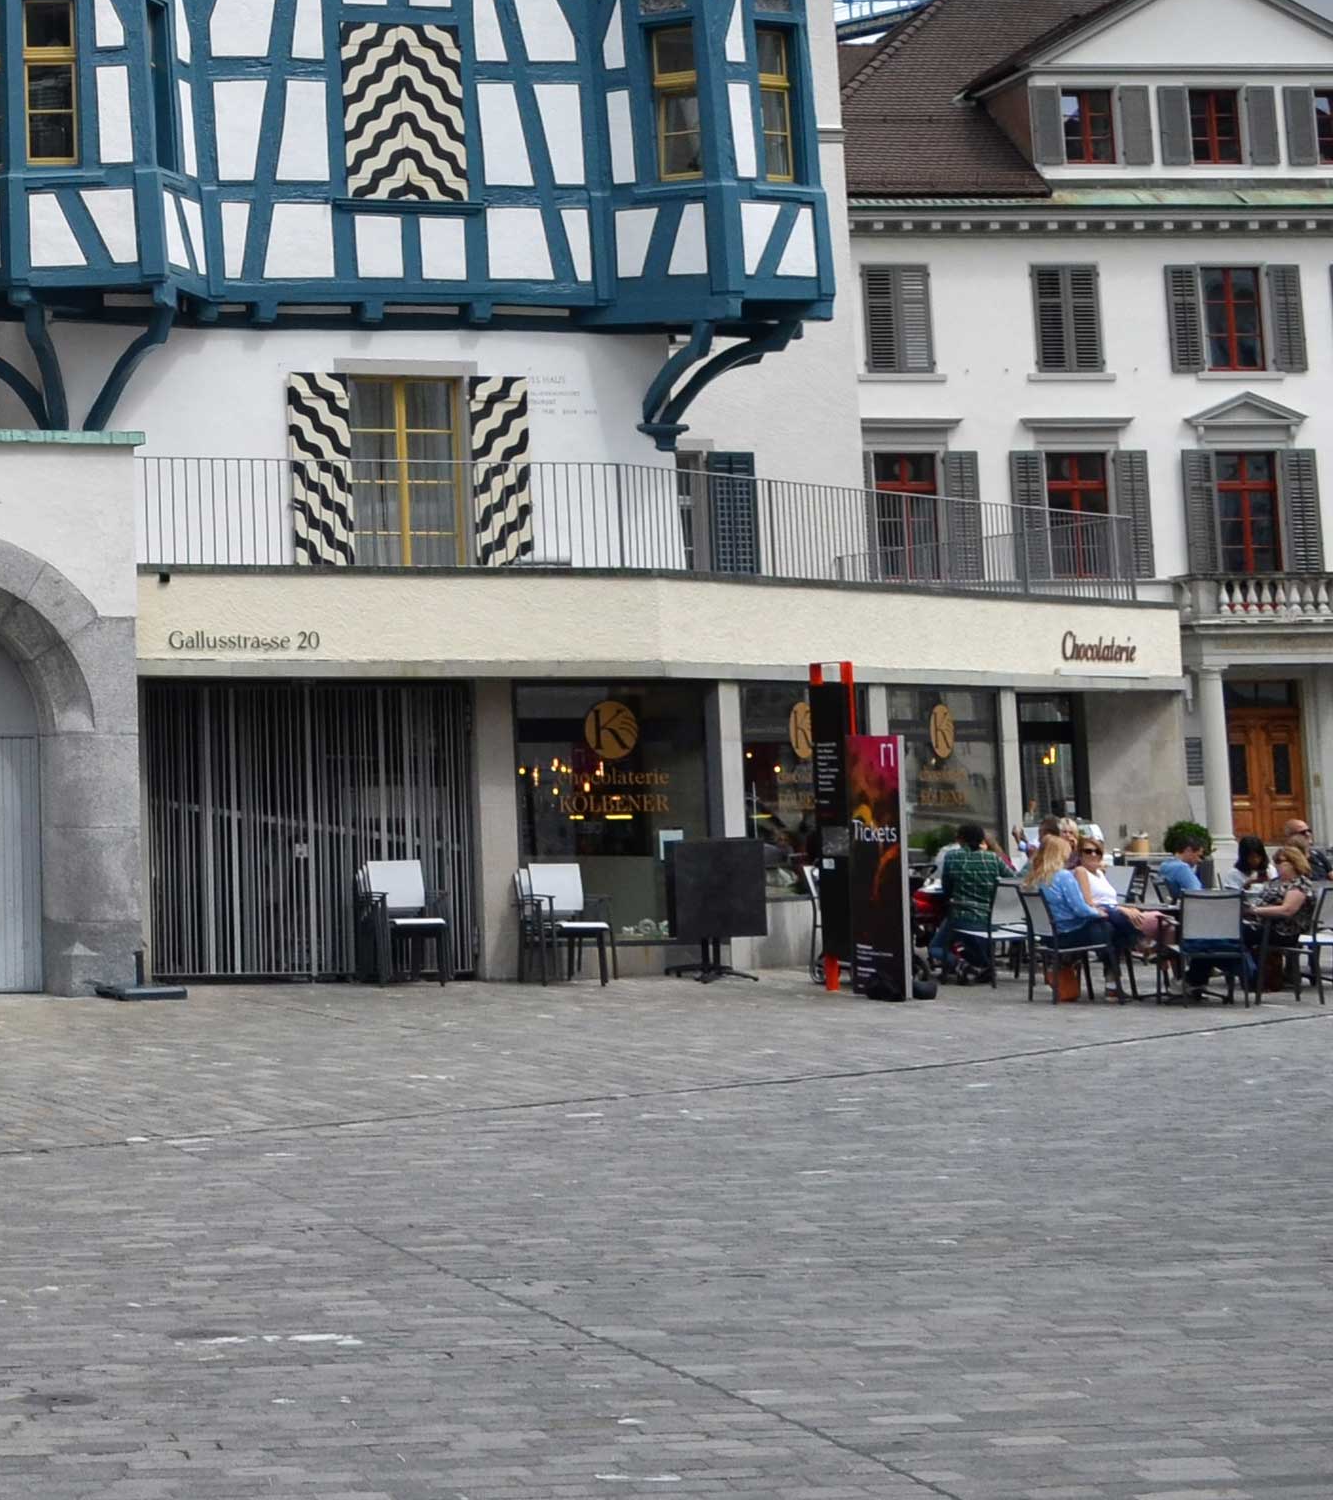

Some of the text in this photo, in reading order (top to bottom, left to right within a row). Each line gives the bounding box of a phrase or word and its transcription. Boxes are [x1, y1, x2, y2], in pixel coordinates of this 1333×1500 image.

[168, 630, 320, 652] Gallusstrasse 20
[1061, 630, 1137, 663] Chocolaterie
[852, 820, 897, 842] Tickets
